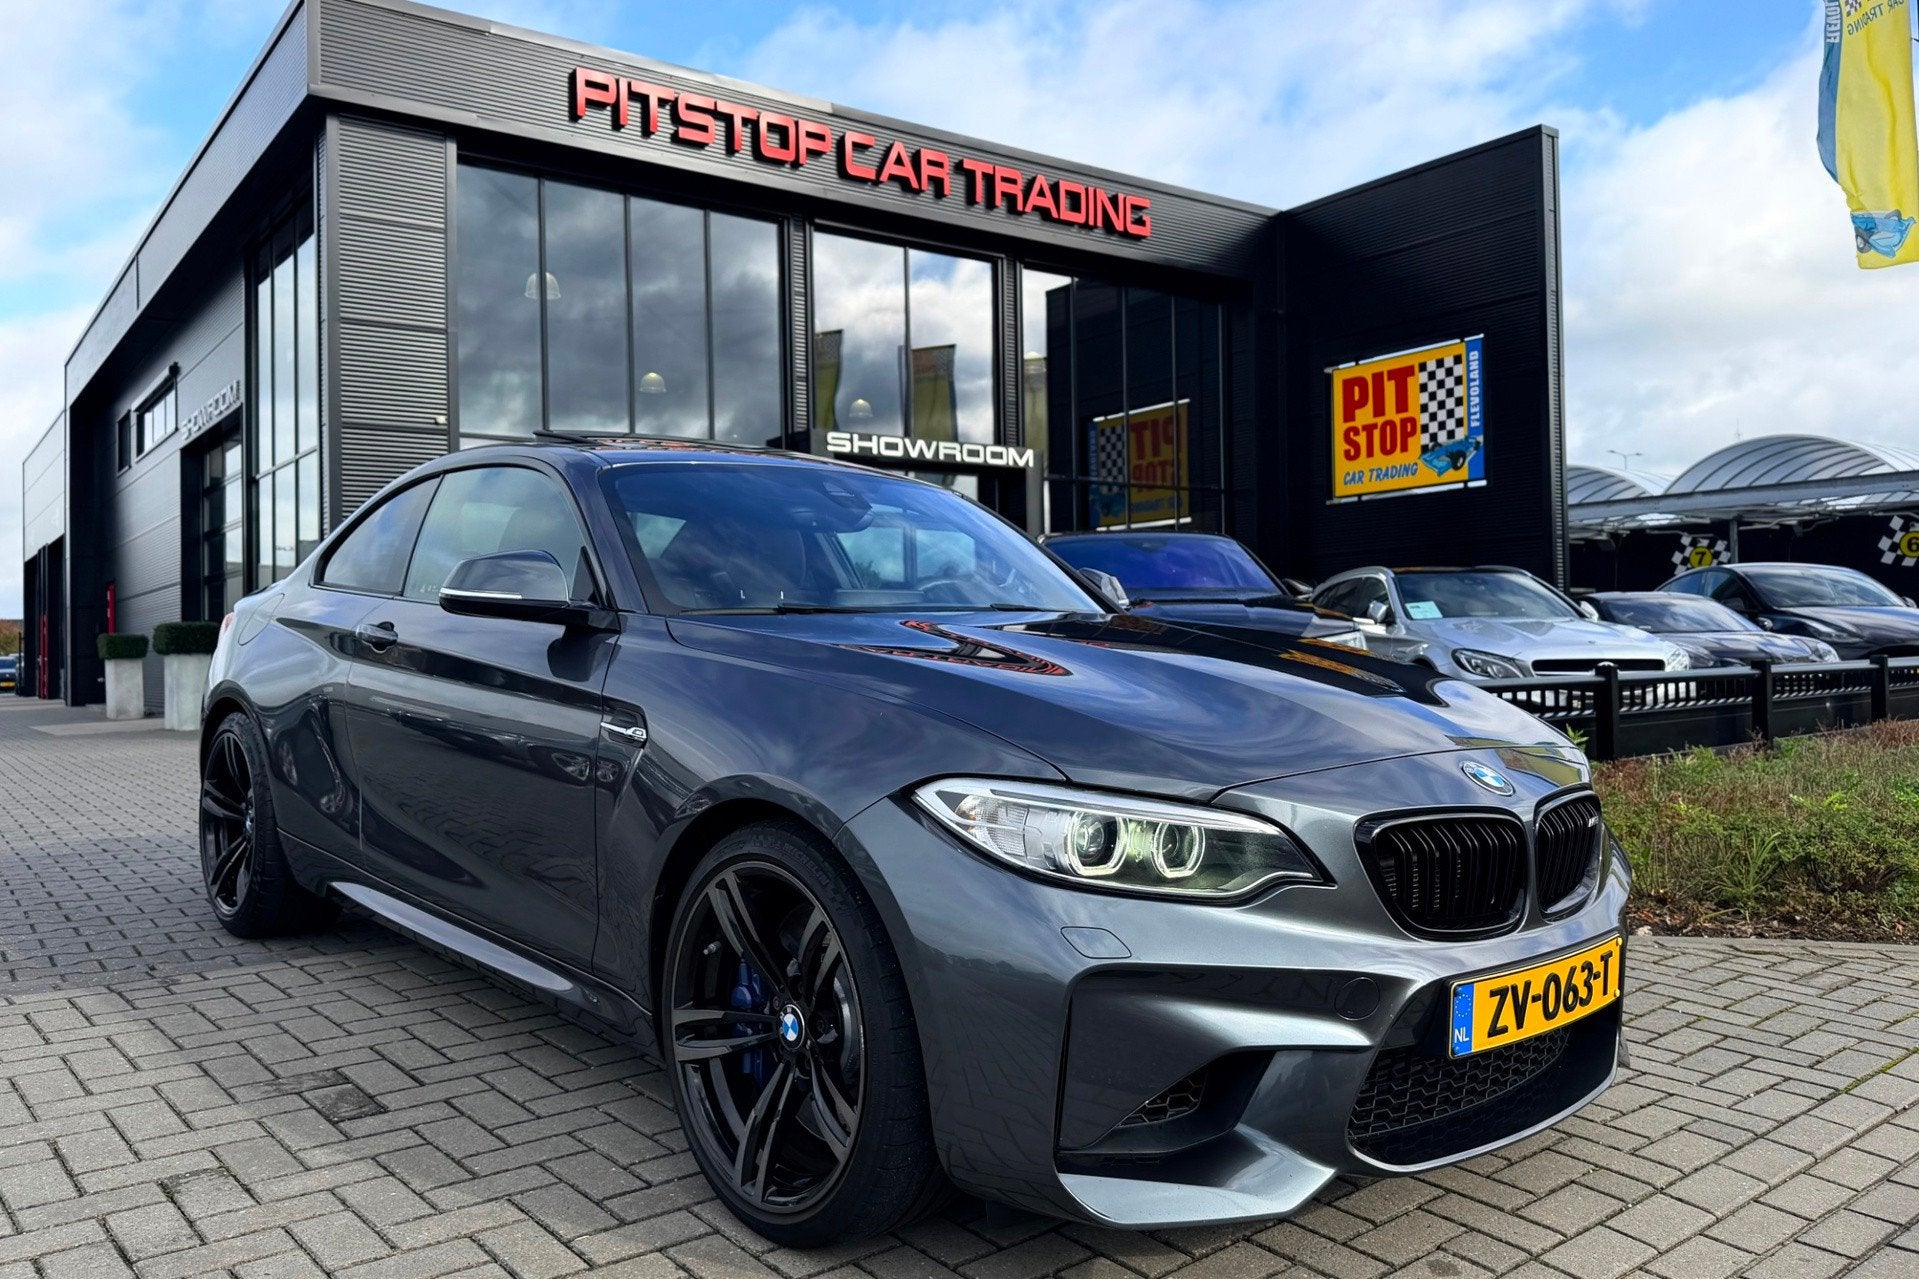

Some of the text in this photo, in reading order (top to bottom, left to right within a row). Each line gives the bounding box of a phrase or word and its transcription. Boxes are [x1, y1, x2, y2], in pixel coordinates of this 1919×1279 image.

[573, 67, 1152, 238] PITSTOP CAR TRADING
[1342, 365, 1415, 423] PIT
[1469, 350, 1480, 427] FLEVOLAND
[826, 431, 1034, 468] SHOWROOM
[1343, 416, 1418, 462] STOP
[1343, 462, 1418, 486] CAR TRADING
[1695, 551, 1707, 566] 7
[1487, 950, 1613, 1039] ZV-063-T
[1454, 1028, 1470, 1044] NL
